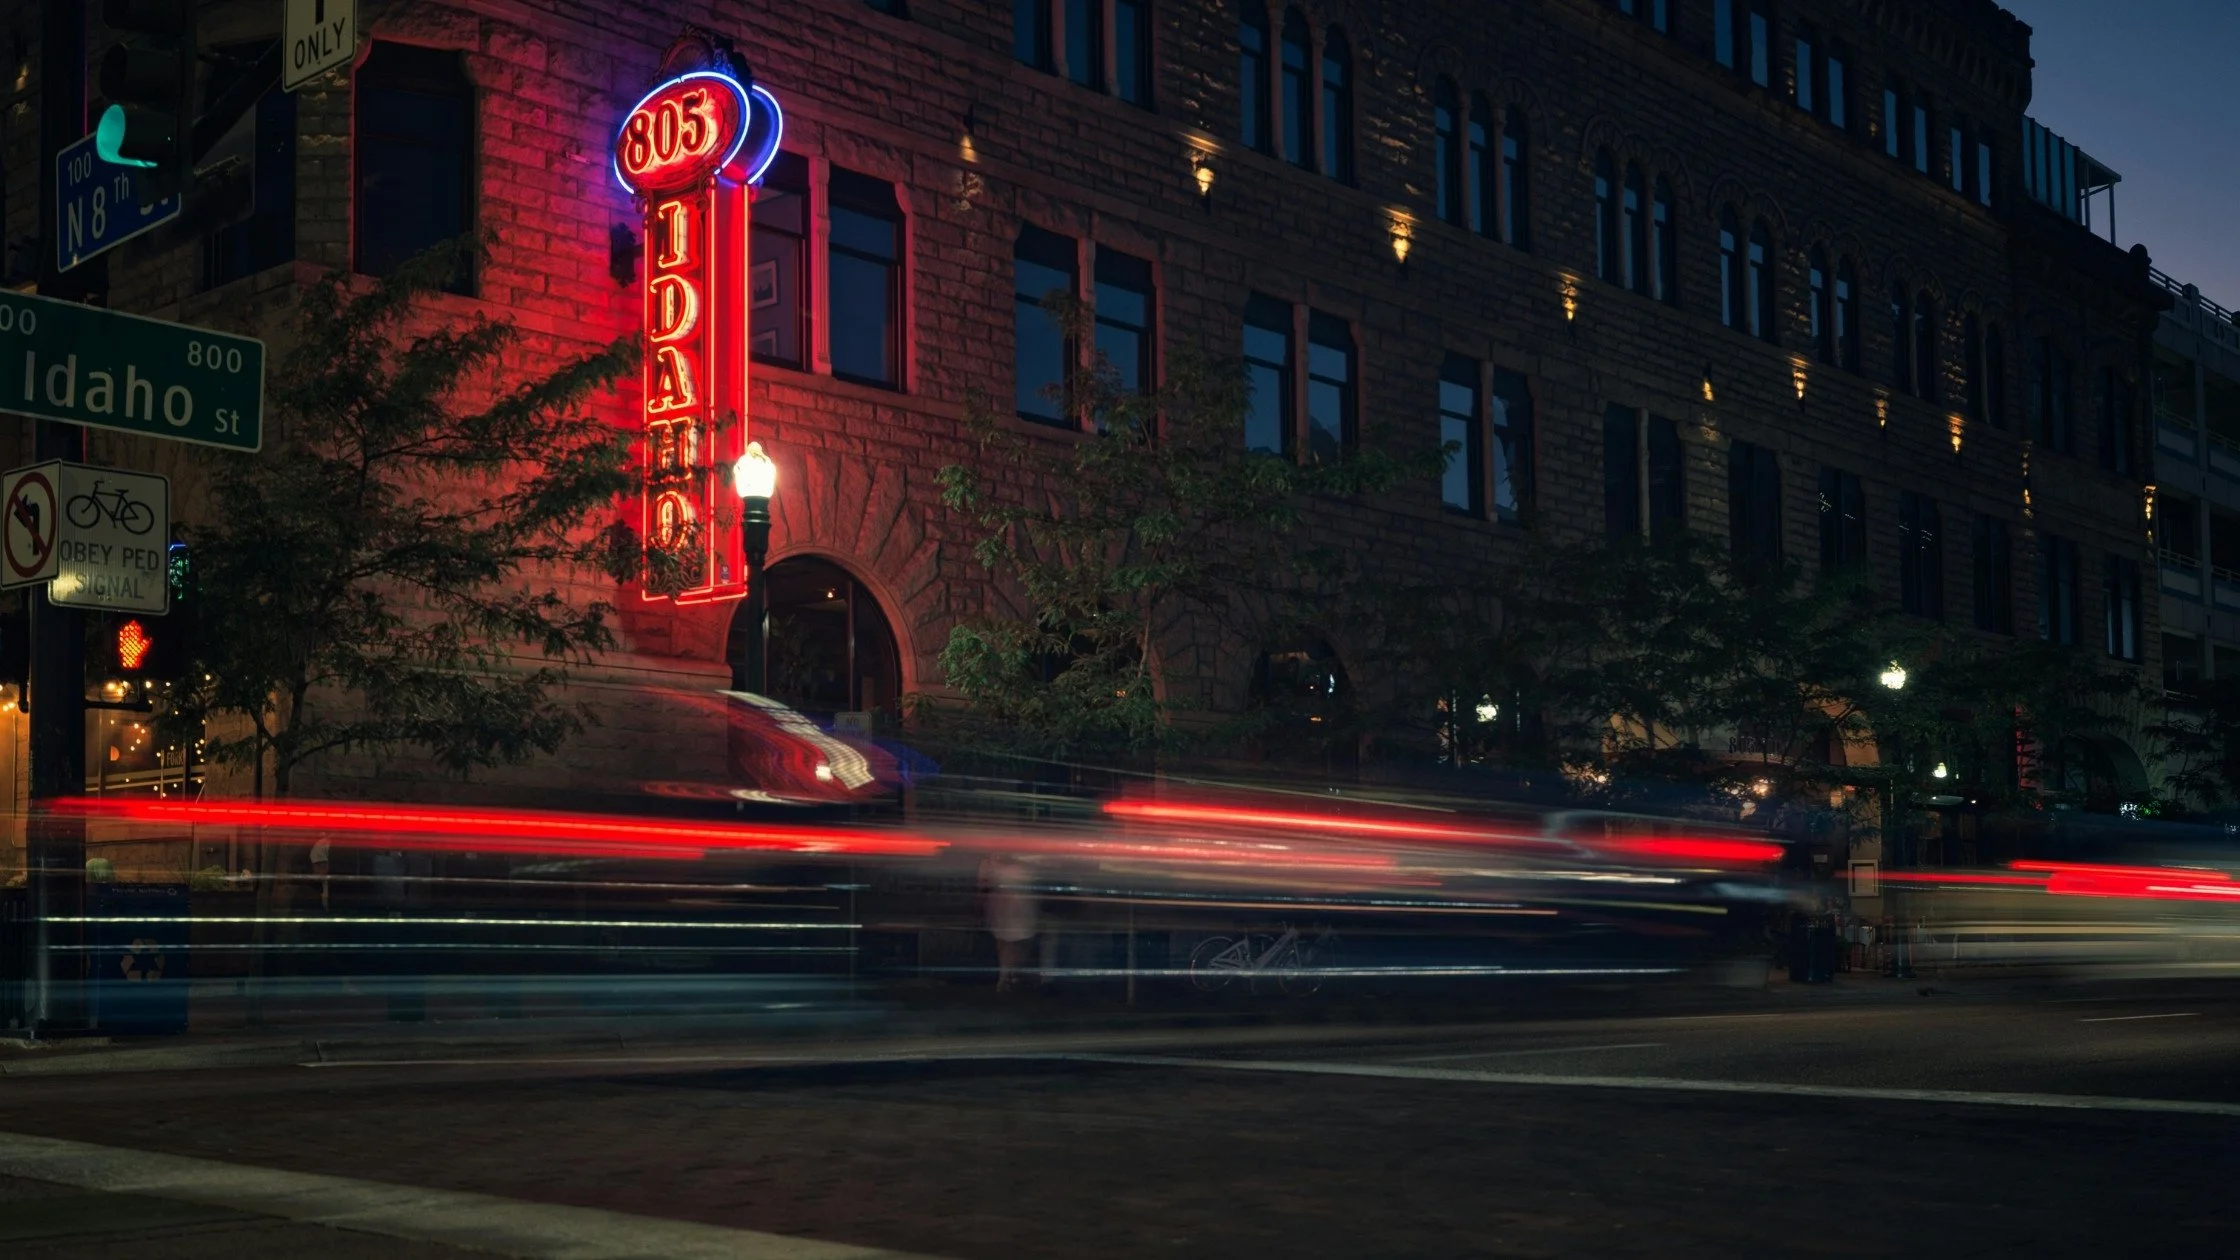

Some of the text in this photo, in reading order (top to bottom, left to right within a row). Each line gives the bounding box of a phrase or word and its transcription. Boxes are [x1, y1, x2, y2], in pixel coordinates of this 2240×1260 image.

[294, 17, 346, 70] ONLY
[624, 87, 711, 175] 805
[67, 151, 92, 187] 100
[67, 195, 84, 253] N
[186, 340, 243, 374] 800
[647, 200, 698, 556] IDAHO
[23, 349, 241, 436] Idaho St
[60, 540, 160, 571] OBEY PED
[75, 573, 145, 600] SIGNAL
